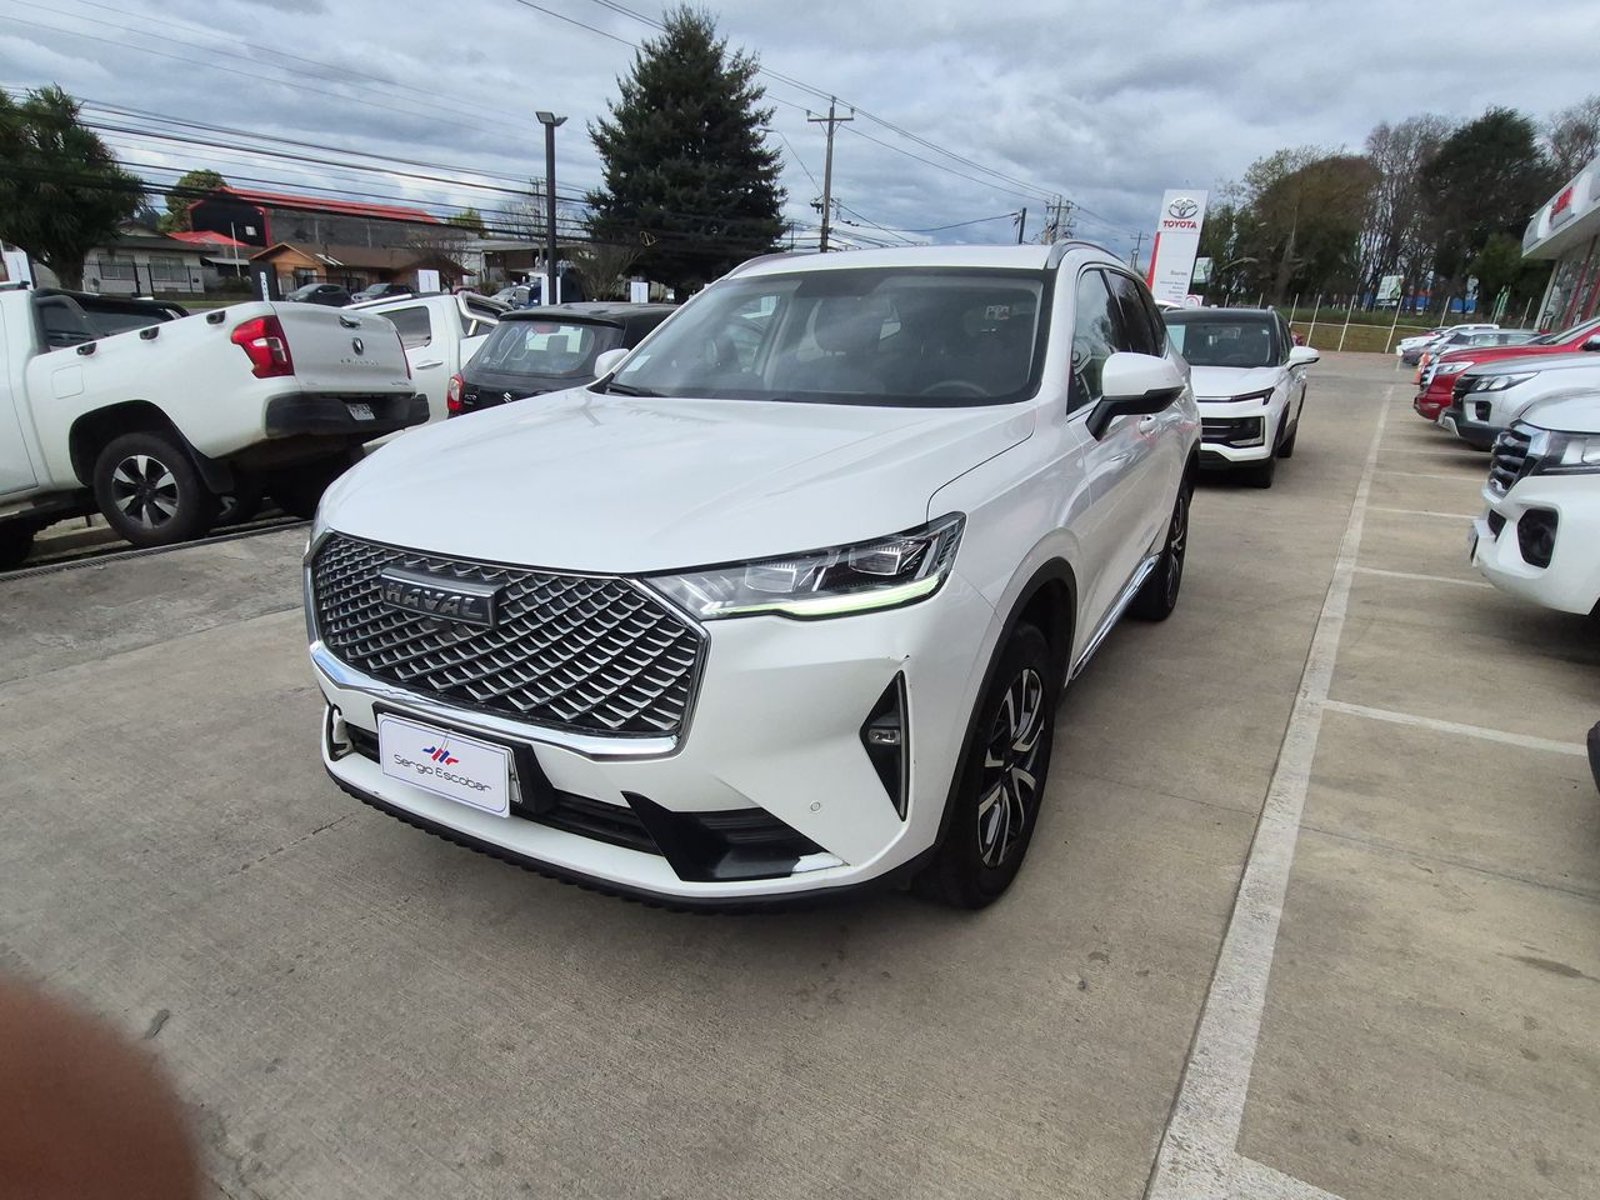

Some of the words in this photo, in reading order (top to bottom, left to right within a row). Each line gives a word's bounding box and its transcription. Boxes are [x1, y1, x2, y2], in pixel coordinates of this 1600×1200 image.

[1163, 220, 1197, 229] TOYOTA
[385, 581, 482, 618] HAVAL
[435, 766, 492, 792] Escobar
